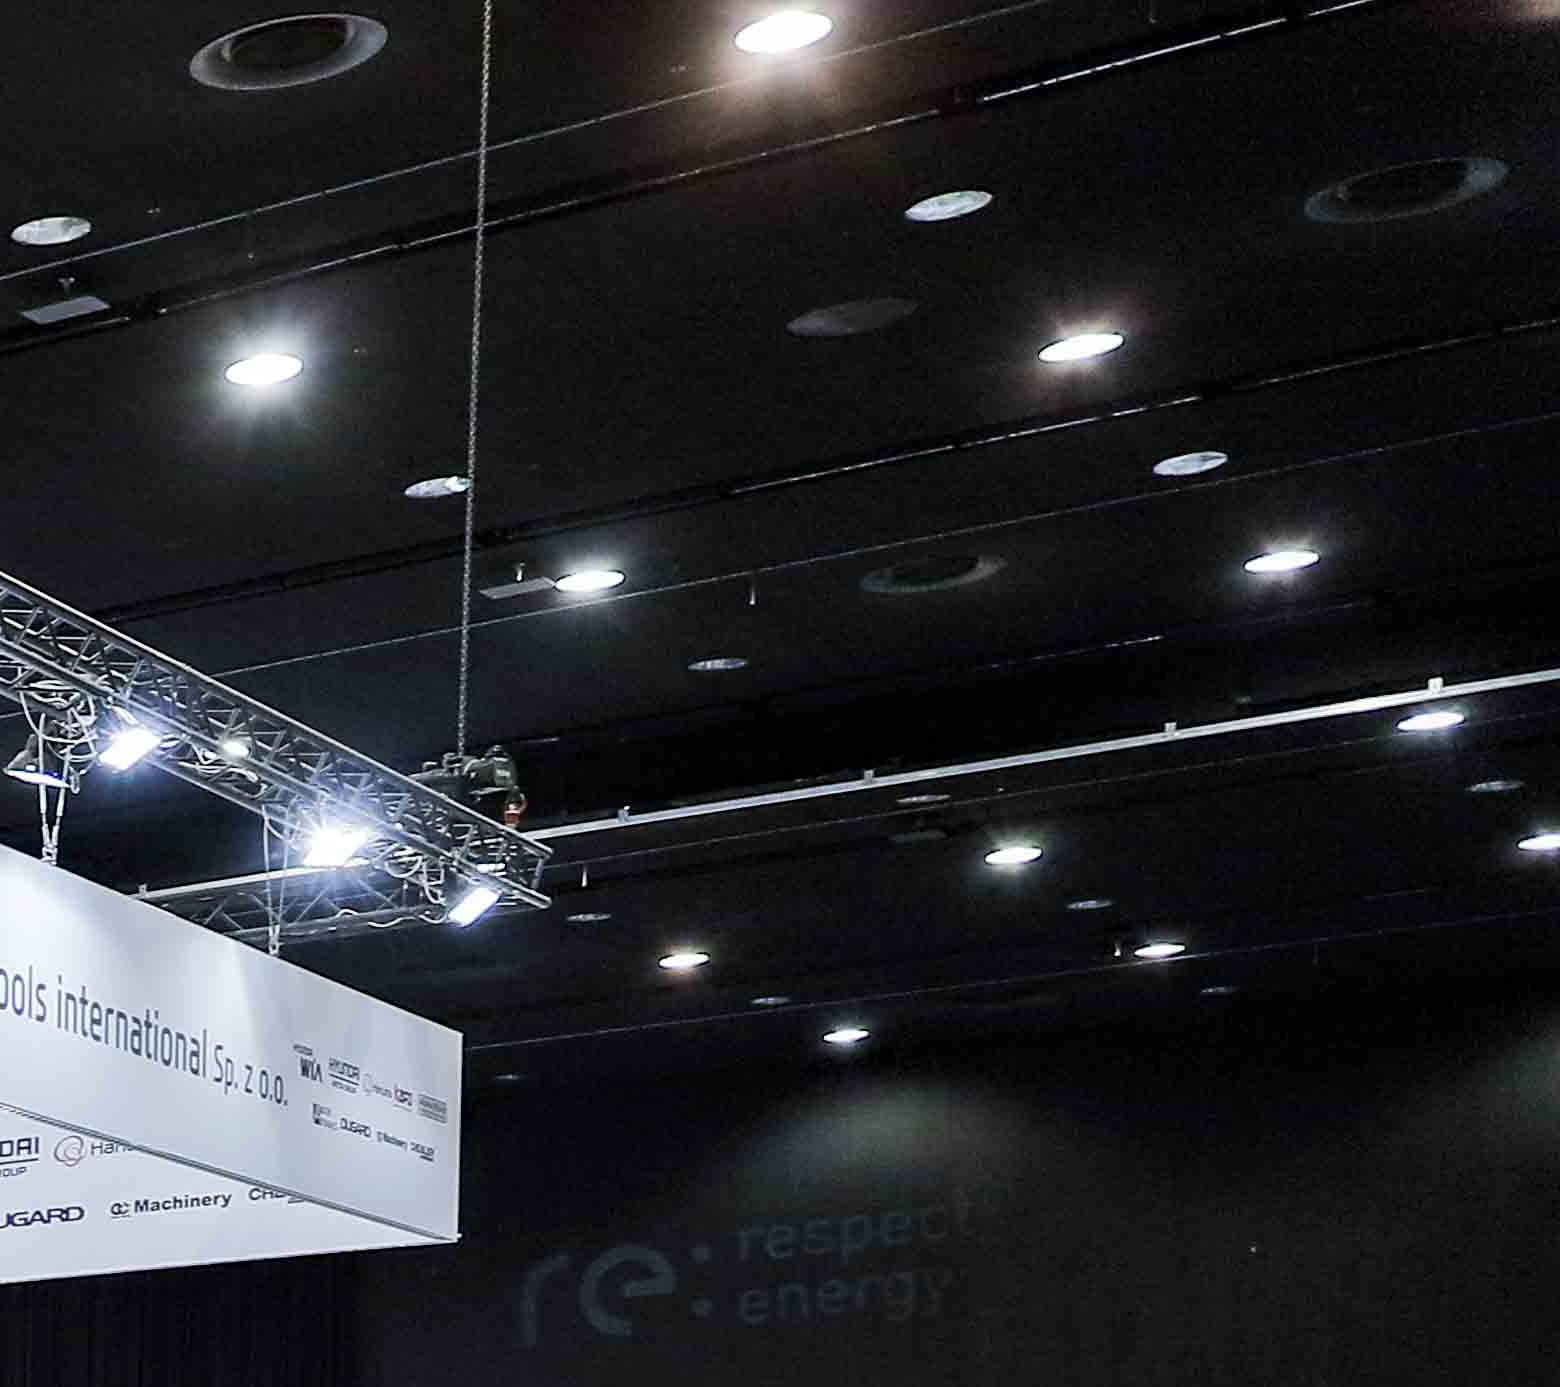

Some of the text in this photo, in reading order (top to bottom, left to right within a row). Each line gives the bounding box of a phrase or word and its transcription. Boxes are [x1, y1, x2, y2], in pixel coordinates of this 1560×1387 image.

[57, 974, 207, 1078] international
[213, 1045, 238, 1095] Sp.
[244, 1065, 253, 1094] z
[259, 1070, 288, 1105] o.o.
[134, 1191, 232, 1214] Machinery
